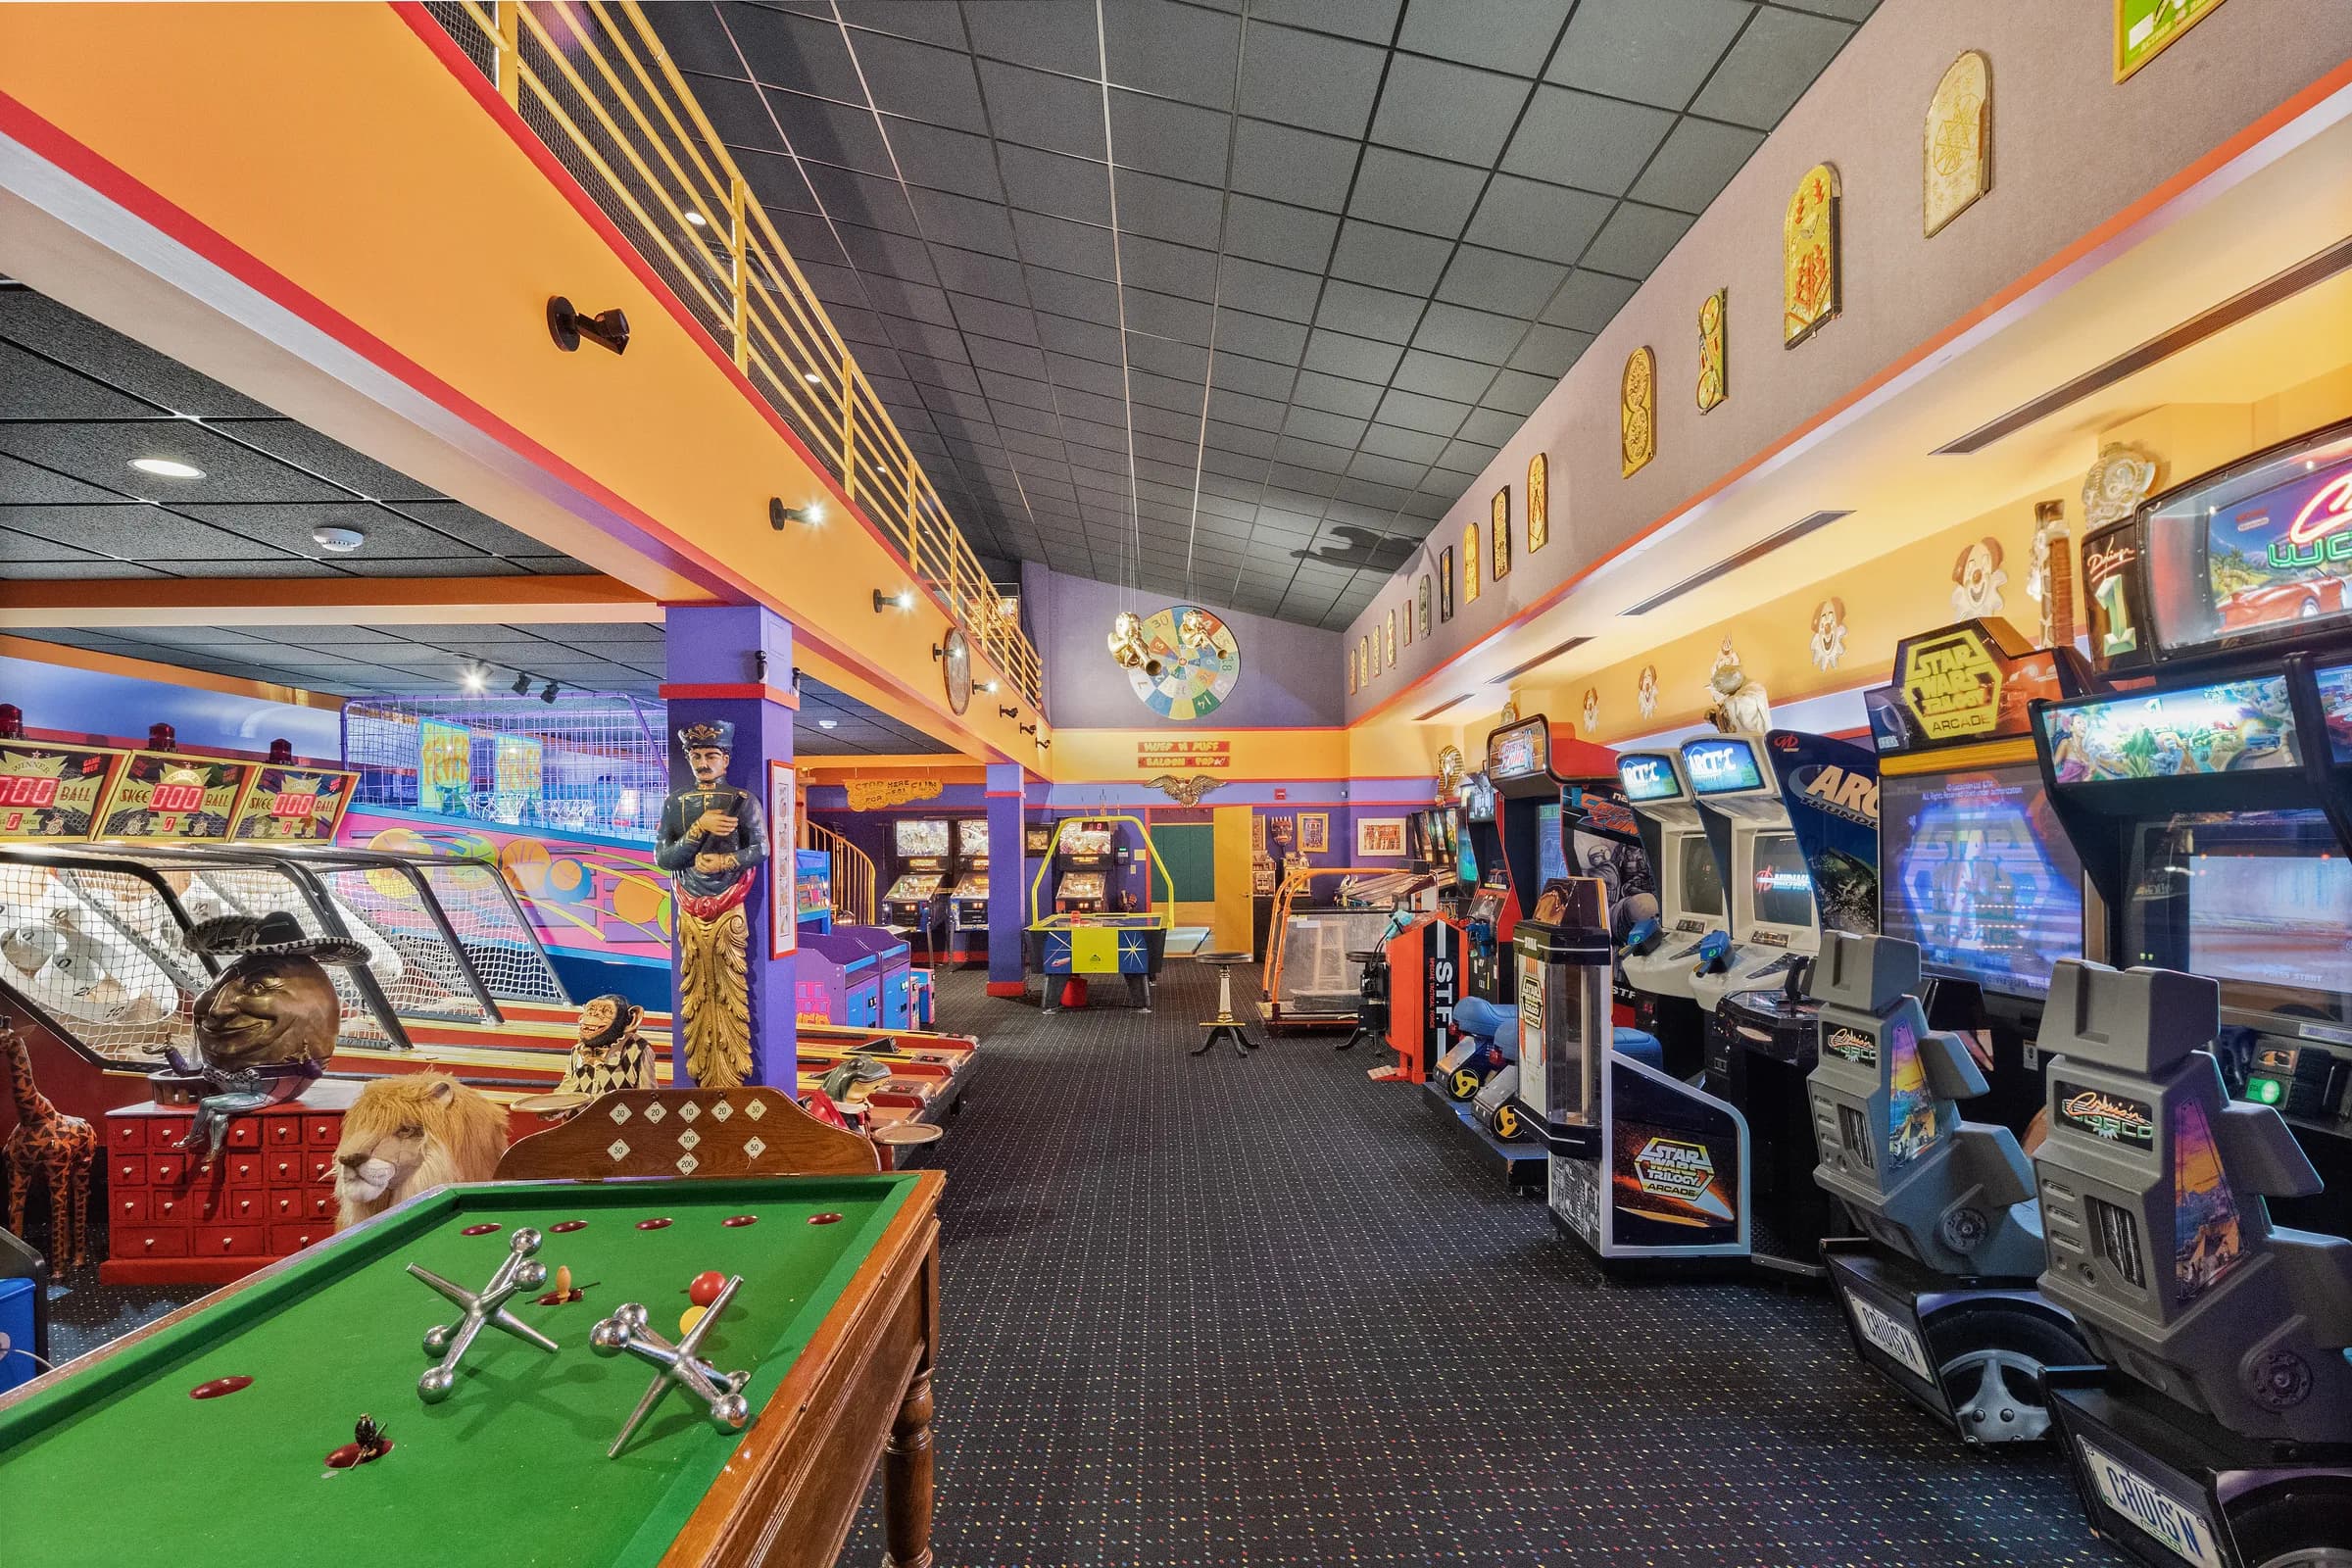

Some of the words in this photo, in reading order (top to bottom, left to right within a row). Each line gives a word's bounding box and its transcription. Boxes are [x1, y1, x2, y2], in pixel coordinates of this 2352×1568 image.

[1152, 614, 1169, 628] 30
[1914, 644, 1981, 676] STAR
[1916, 670, 1980, 699] WARS
[1932, 714, 1991, 732] ARCADE
[12, 760, 50, 774] WINNER
[82, 756, 103, 766] GAME
[81, 763, 99, 774] OVER
[887, 779, 909, 789] HERE
[60, 786, 90, 802] BALL
[120, 788, 151, 804] SKEE
[150, 785, 202, 809] 000
[204, 793, 228, 808] BALL
[249, 797, 273, 810] SKEE
[272, 794, 314, 814] 000
[315, 800, 334, 812] BALL
[164, 817, 174, 831] 0
[2294, 972, 2323, 983] START
[651, 1107, 661, 1116] 20
[685, 1107, 694, 1116] 10
[717, 1106, 727, 1115] 20
[751, 1105, 760, 1114] 30
[613, 1146, 623, 1154] 50
[683, 1135, 695, 1144] 100
[1648, 1145, 1704, 1164] STAR
[681, 1159, 694, 1168] 200
[1649, 1157, 1698, 1177] WARS
[1646, 1169, 1699, 1186] TRILOGY
[1646, 1183, 1696, 1197] ARCADE
